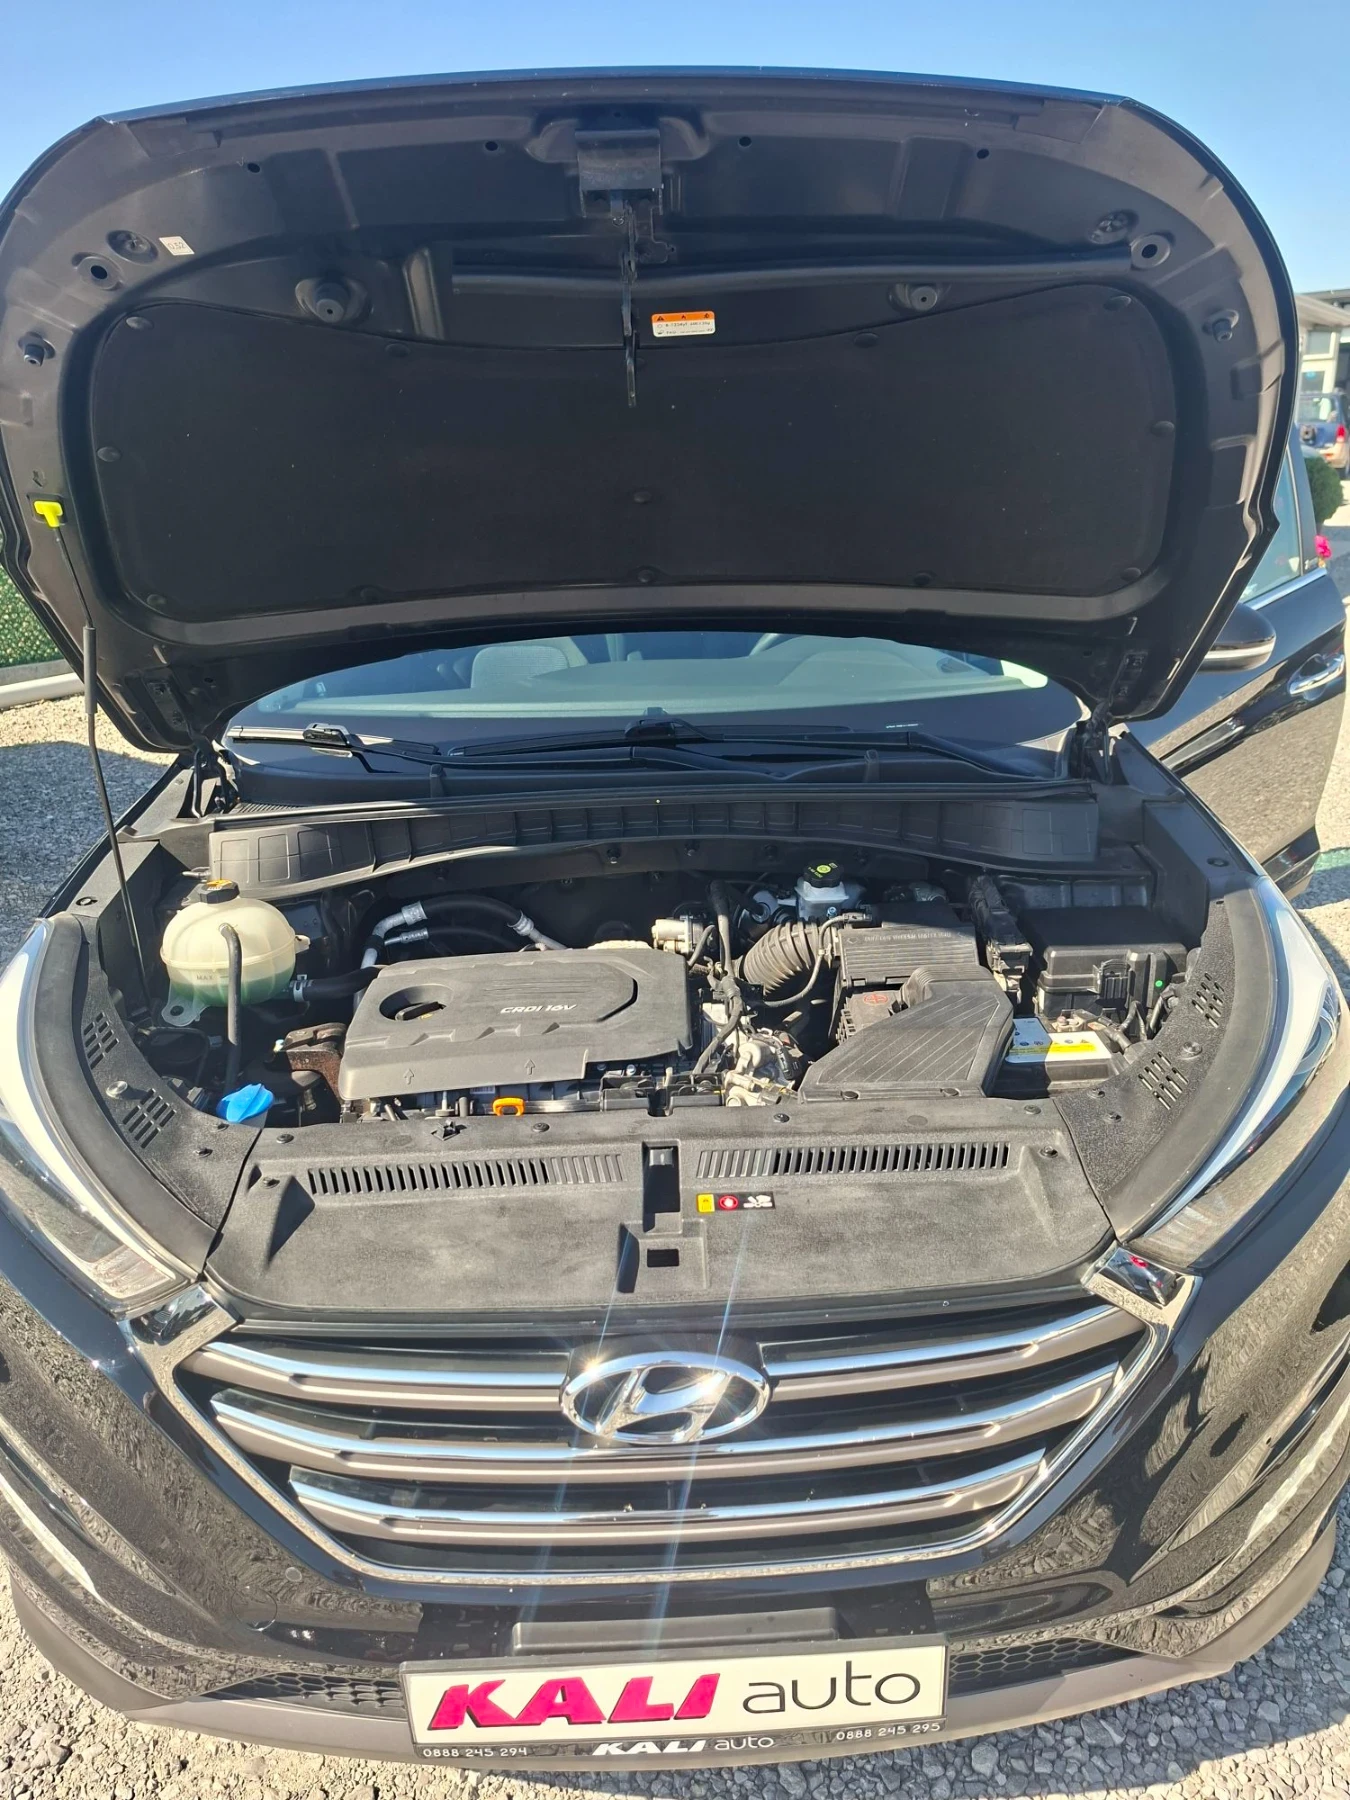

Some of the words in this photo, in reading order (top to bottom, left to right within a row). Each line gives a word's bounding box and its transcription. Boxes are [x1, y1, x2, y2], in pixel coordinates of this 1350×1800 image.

[500, 1005, 542, 1014] CRDI
[545, 1004, 577, 1012] 16V
[427, 1673, 720, 1730] KALI
[743, 1661, 921, 1713] auto
[836, 1729, 872, 1741] 0888
[878, 1725, 906, 1736] 245
[912, 1722, 941, 1734] 295
[423, 1748, 460, 1758] 0888
[465, 1747, 495, 1757] 245
[500, 1746, 528, 1757] 294
[592, 1739, 706, 1756] KALI
[714, 1736, 774, 1750] auto
